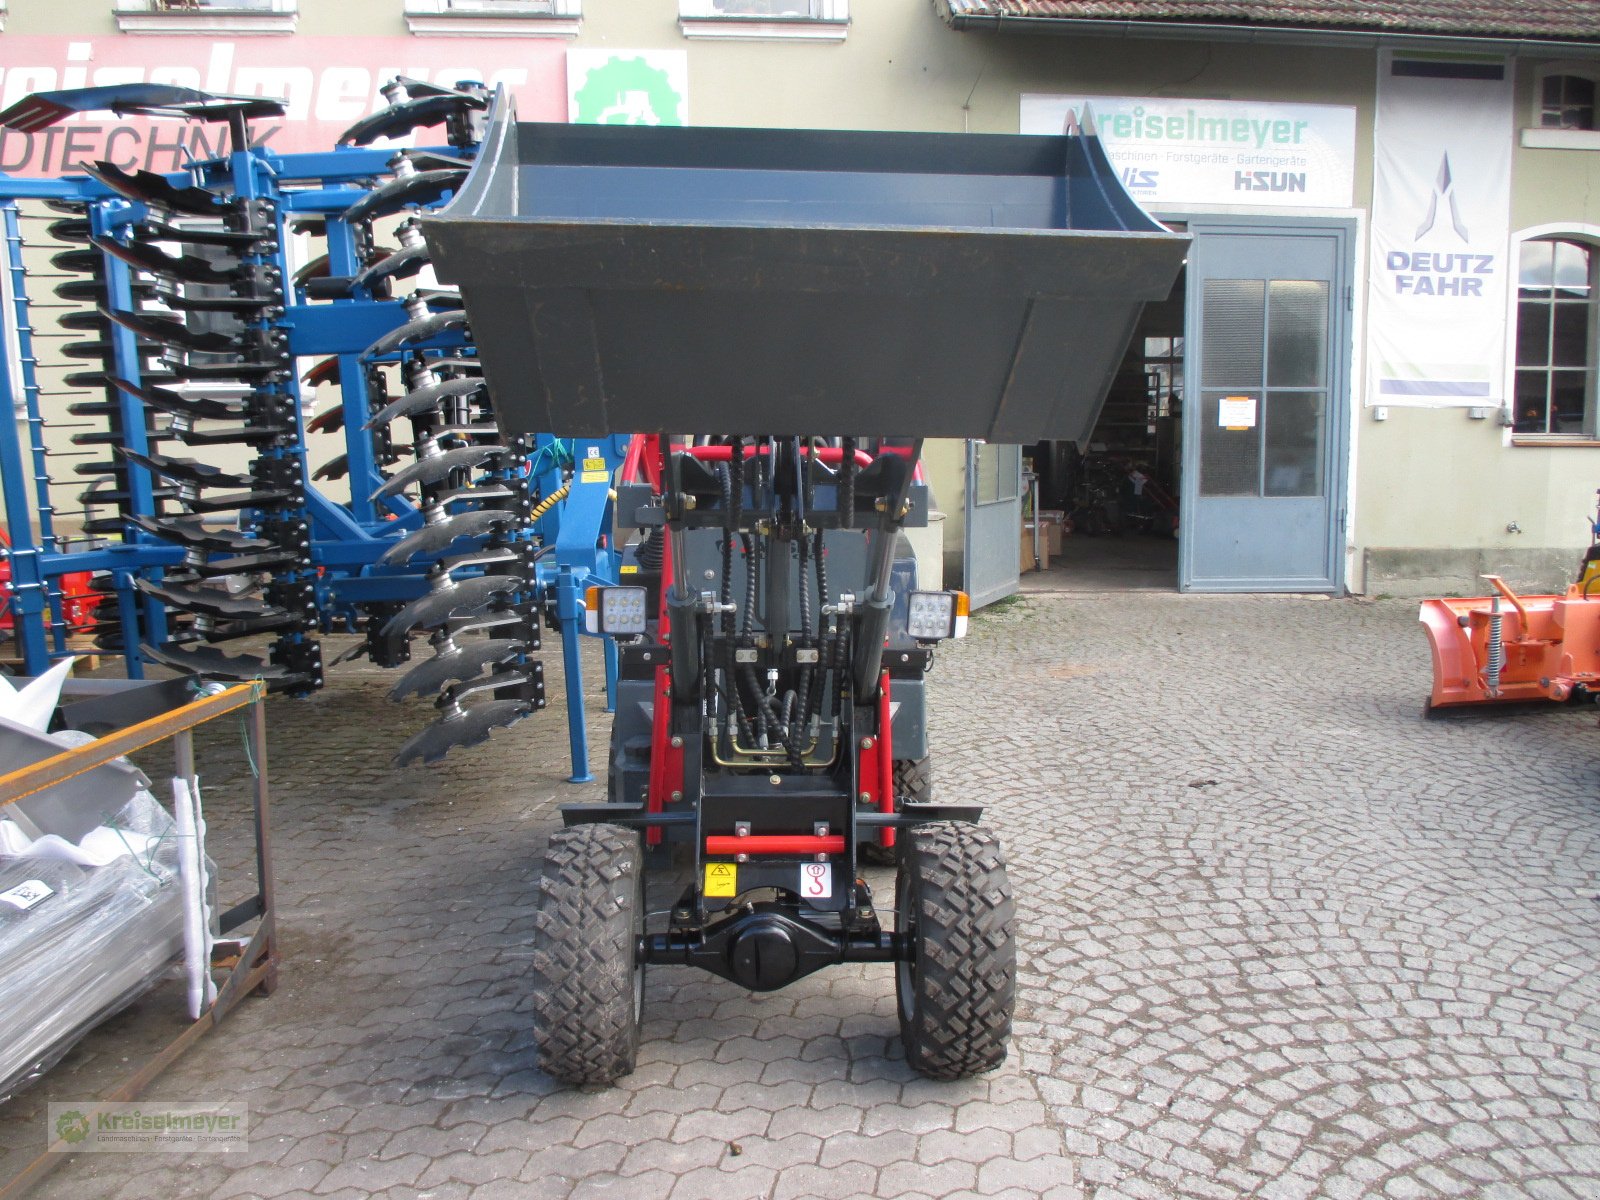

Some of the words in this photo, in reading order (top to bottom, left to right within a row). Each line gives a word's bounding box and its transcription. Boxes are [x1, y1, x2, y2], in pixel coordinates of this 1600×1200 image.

[1166, 152, 1229, 165] Forstgeräte
[1237, 153, 1307, 167] Gartengeräte
[1387, 251, 1494, 274] DEUTZ
[1395, 275, 1483, 297] FAHR
